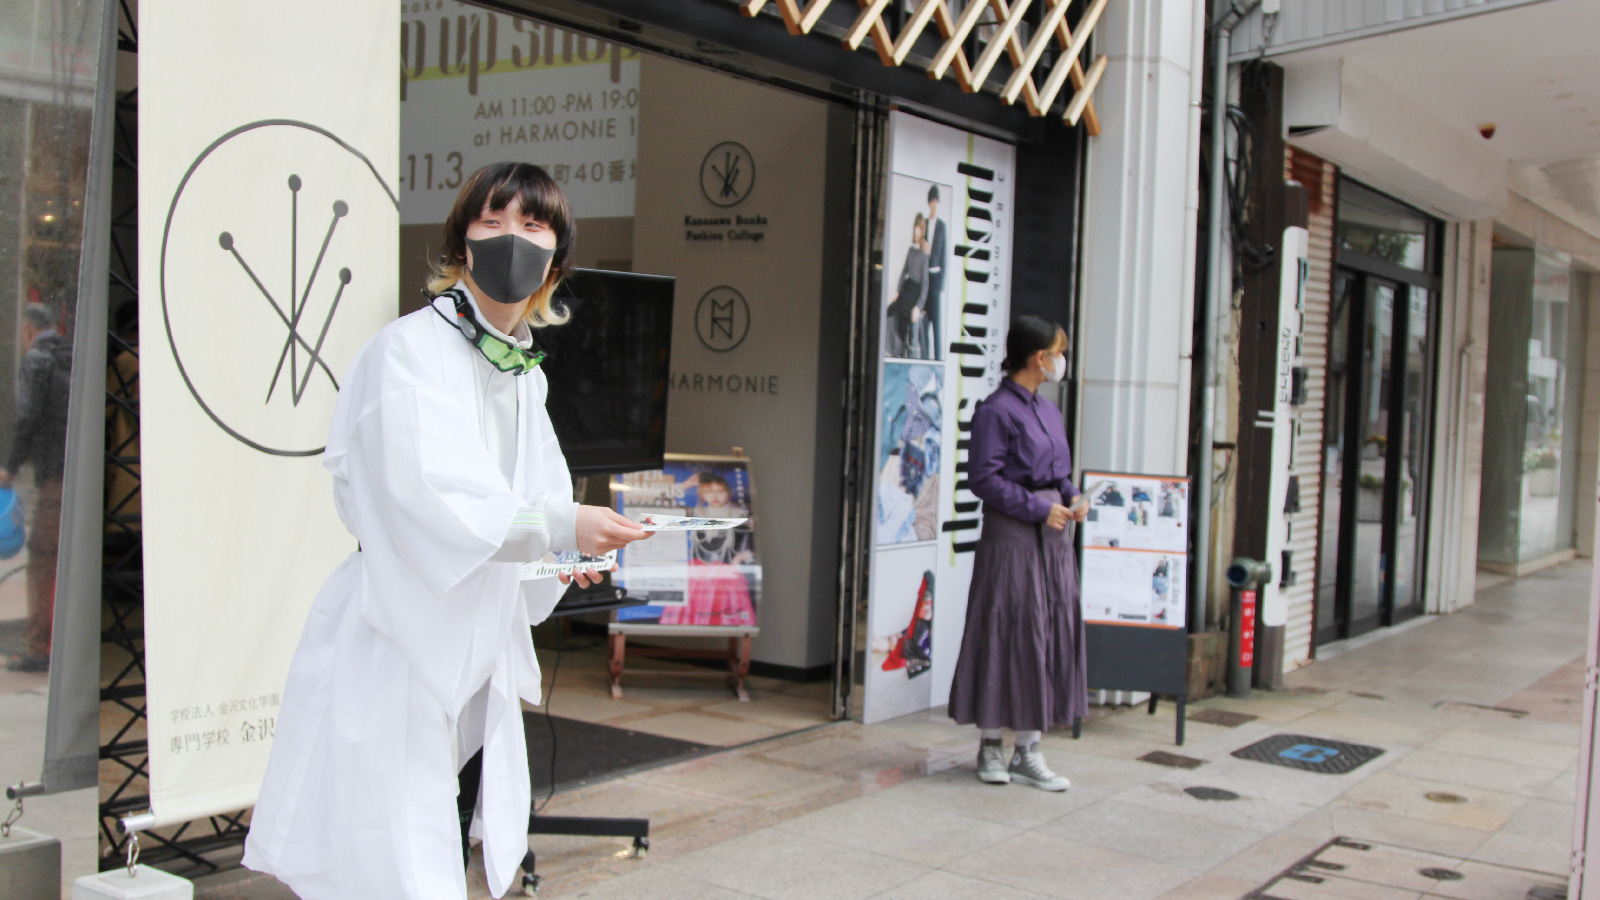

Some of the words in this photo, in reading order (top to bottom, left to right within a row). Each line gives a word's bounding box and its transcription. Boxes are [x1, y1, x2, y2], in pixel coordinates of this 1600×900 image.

[440, 12, 498, 95] up
[474, 102, 503, 120] AM
[511, 95, 556, 117] 11:00
[474, 130, 491, 147] at
[500, 118, 616, 144] HARMONIE
[540, 159, 638, 184] 町40番
[686, 229, 724, 241] Fashion
[727, 229, 764, 243] College
[953, 161, 995, 284] pop
[949, 303, 989, 378] up
